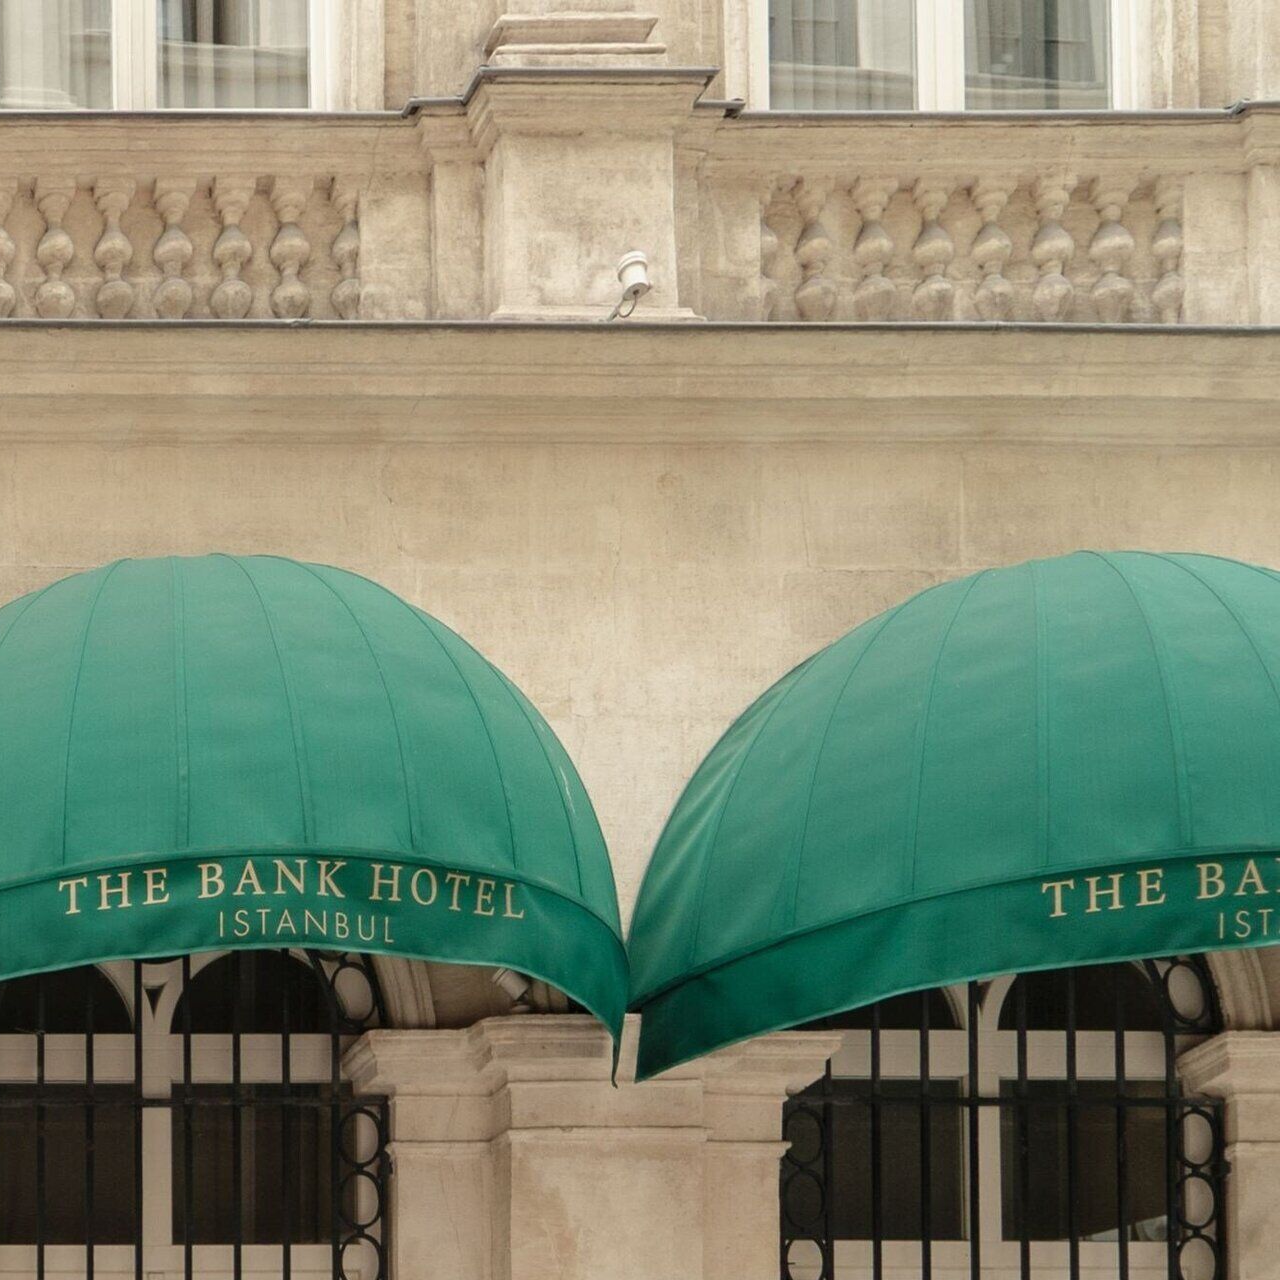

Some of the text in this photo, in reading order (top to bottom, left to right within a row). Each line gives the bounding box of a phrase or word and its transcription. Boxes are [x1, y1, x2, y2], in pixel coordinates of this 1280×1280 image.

[58, 858, 525, 920] THE BANK HOTEL
[1041, 858, 1280, 918] THE BA
[218, 908, 394, 944] ISTANBUL
